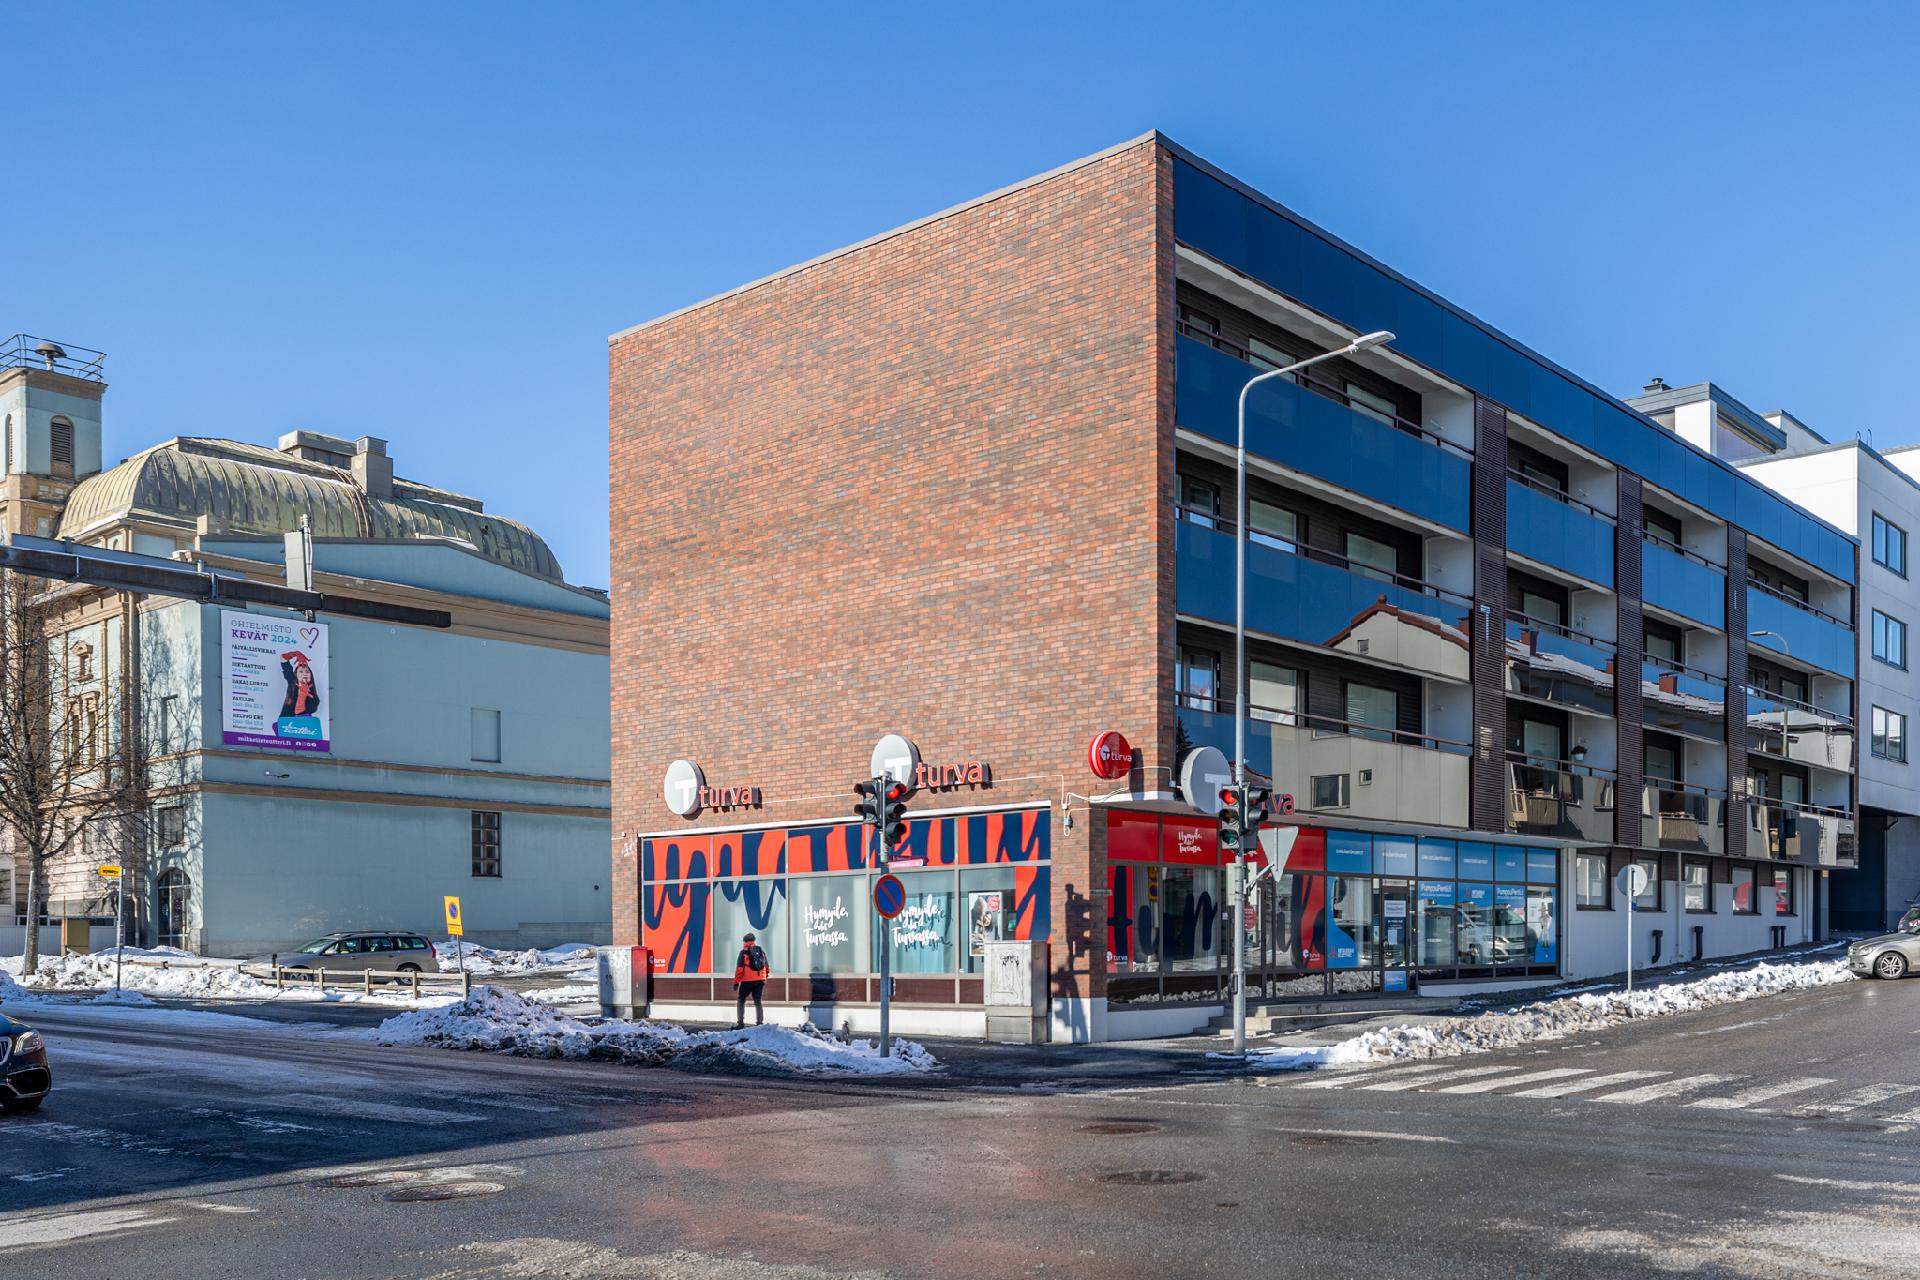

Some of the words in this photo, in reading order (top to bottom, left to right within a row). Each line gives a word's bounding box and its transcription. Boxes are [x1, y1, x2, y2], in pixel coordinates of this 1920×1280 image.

[232, 619, 292, 634] OHJELMISTO
[232, 629, 268, 641] KEVÄT
[271, 634, 297, 644] 2024
[1111, 752, 1132, 762] turva
[915, 760, 983, 788] turva
[699, 784, 753, 808] turva
